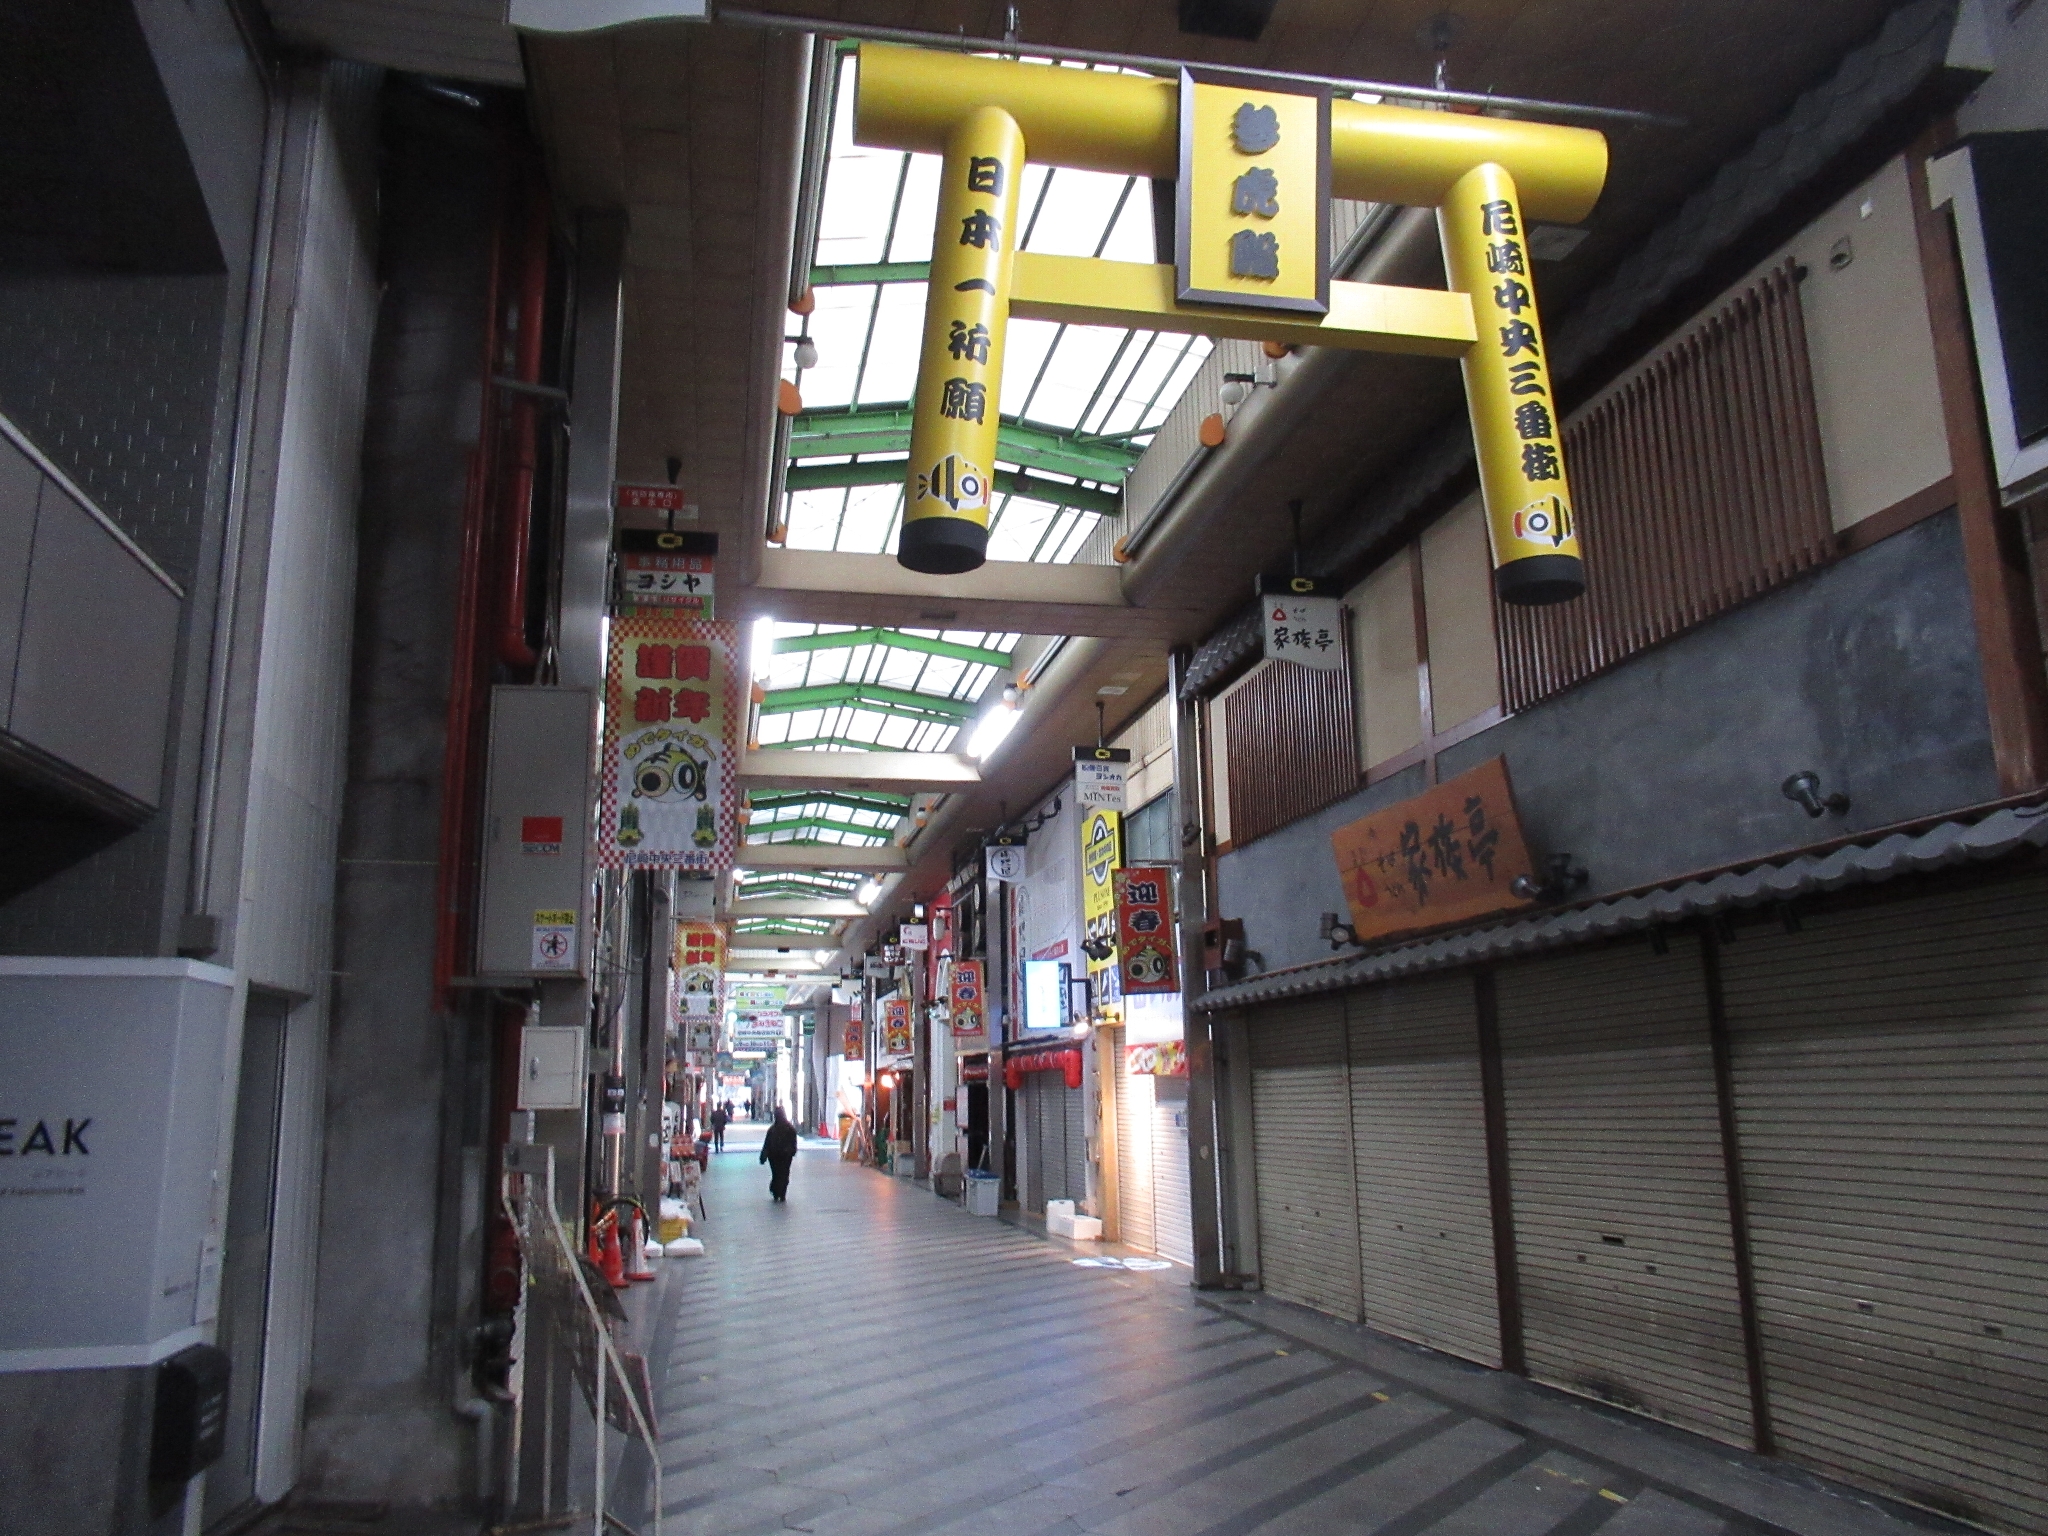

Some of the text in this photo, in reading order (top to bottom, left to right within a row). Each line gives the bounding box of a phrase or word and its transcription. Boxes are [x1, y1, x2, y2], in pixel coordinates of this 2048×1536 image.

[940, 156, 1005, 426] 日本一祈願
[1480, 199, 1561, 482] 尼崎中央三番街
[1273, 626, 1335, 653] 家族亭
[1095, 772, 1123, 781] ヨシオカ
[1399, 794, 1500, 907] 家族亭
[1127, 882, 1162, 933] 迎春
[0, 1118, 94, 1156] EAK
